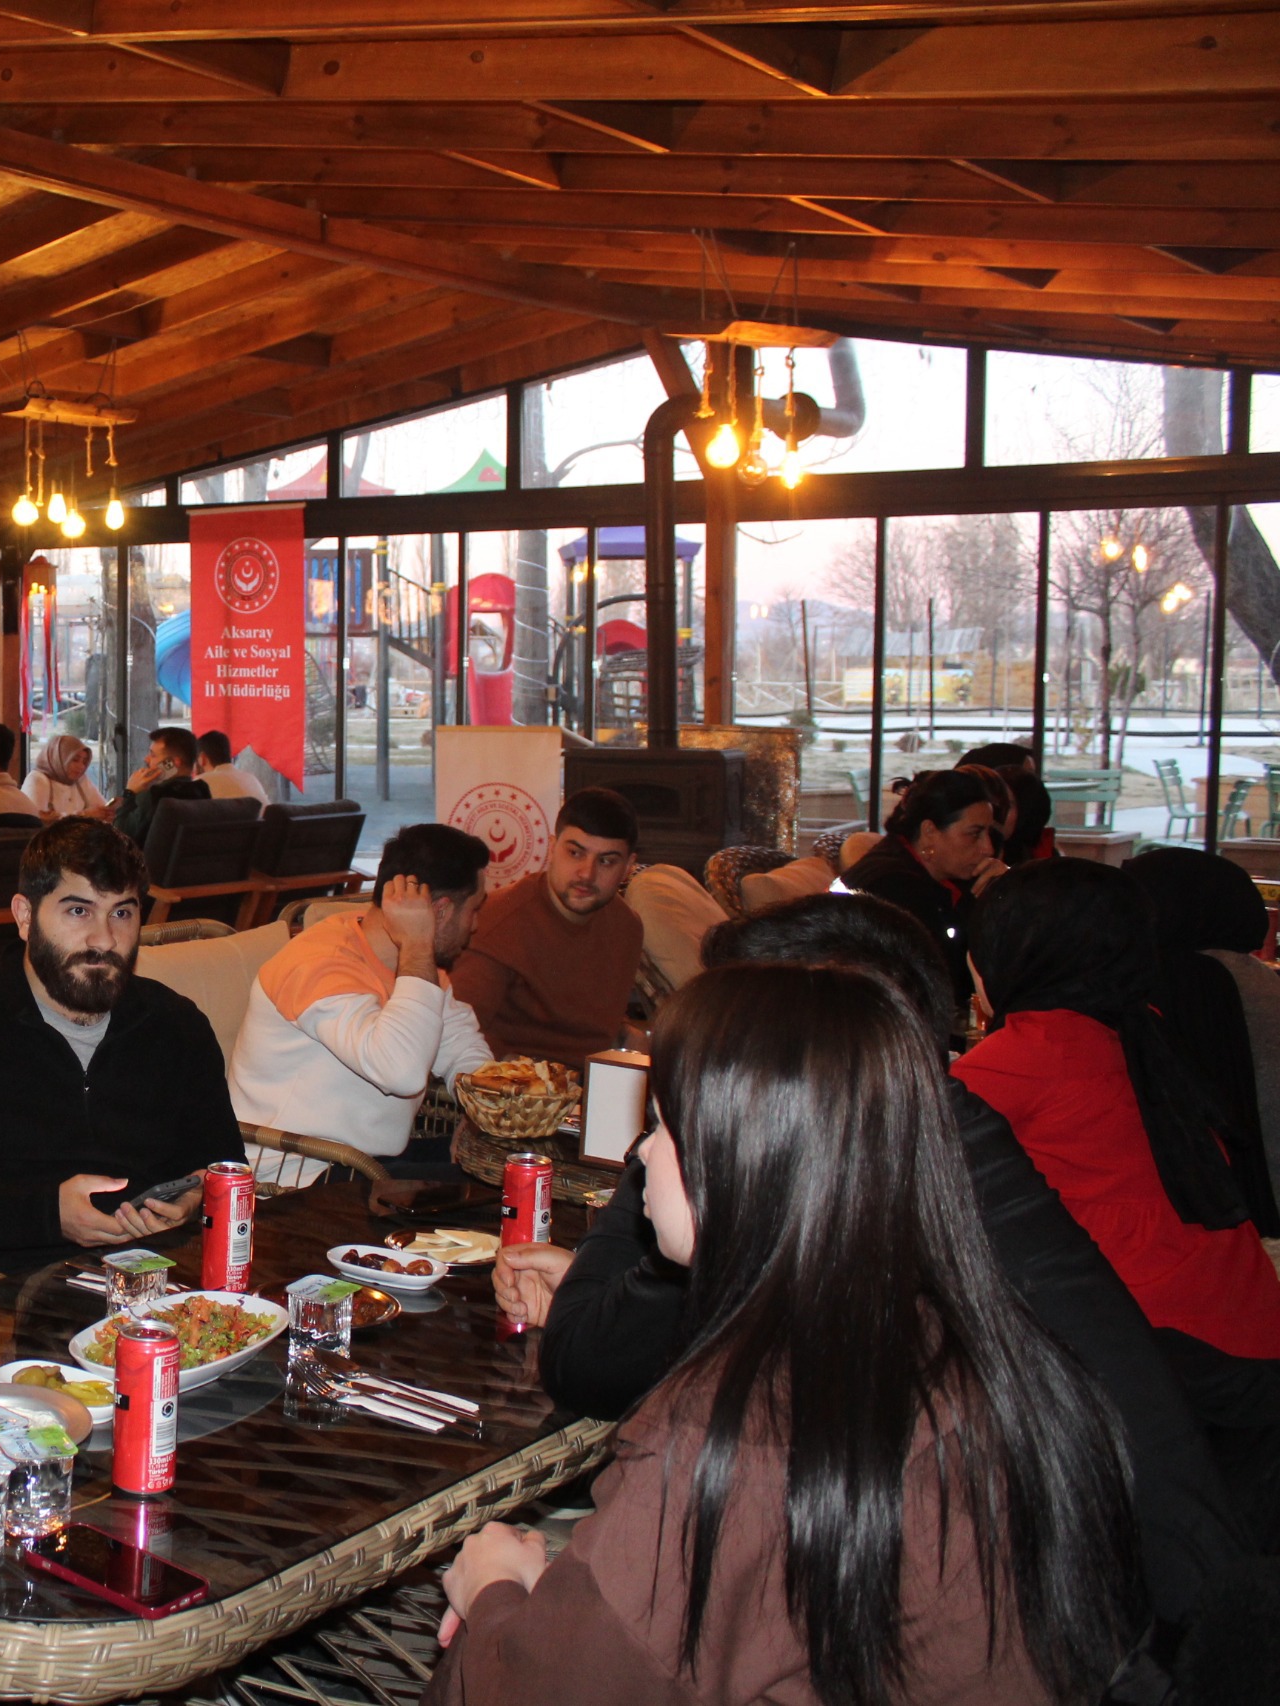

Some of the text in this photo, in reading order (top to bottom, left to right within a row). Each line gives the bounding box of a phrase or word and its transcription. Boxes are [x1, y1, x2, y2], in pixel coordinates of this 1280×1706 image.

[221, 625, 274, 642] Aksaray
[204, 644, 291, 662] Aile ve Sosyal
[216, 664, 279, 678] Hizmetler
[204, 680, 291, 701] İl Müdürlüğü
